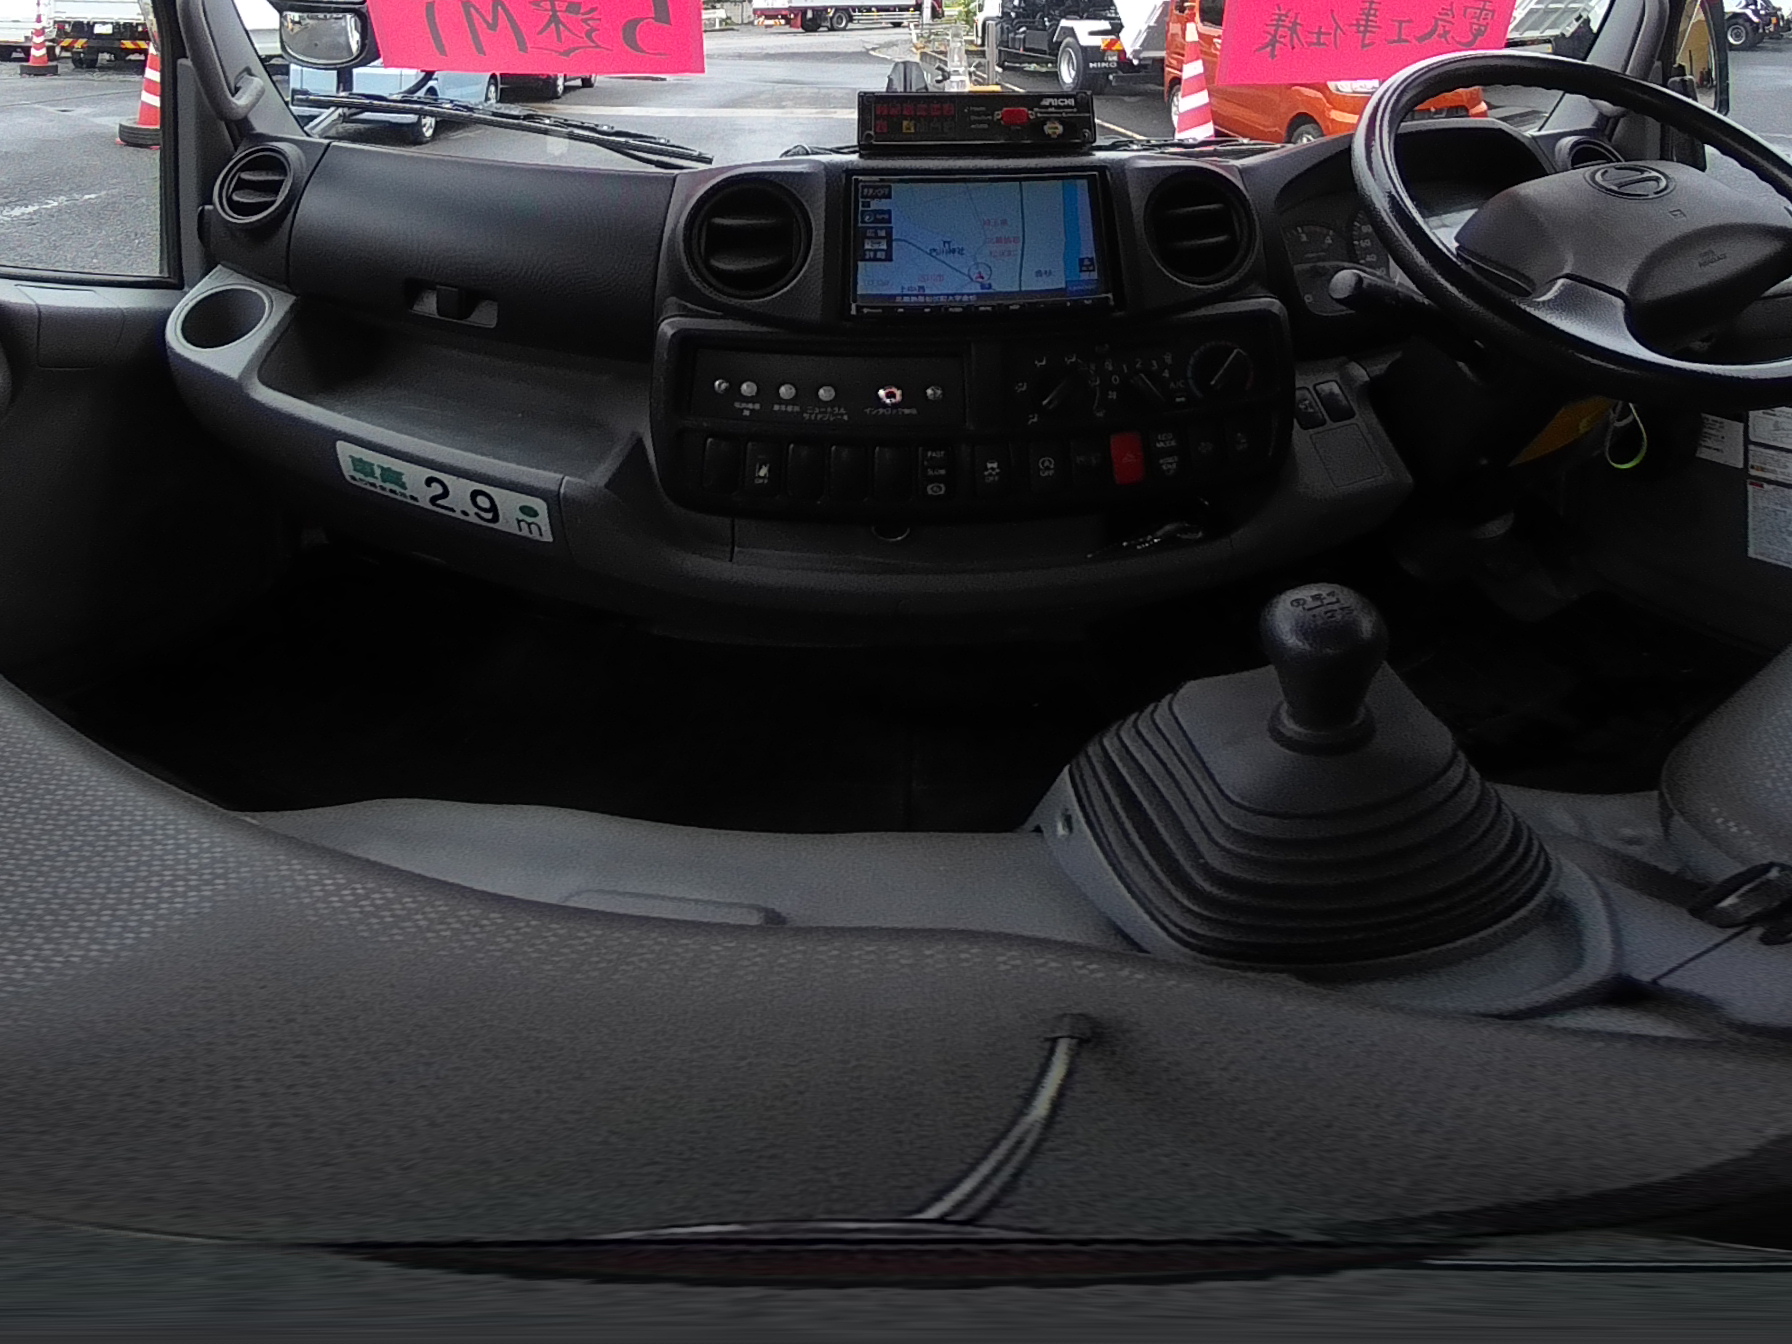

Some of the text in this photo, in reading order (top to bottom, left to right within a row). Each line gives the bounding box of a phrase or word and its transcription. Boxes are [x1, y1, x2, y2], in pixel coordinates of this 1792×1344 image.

[1135, 358, 1143, 368] 2
[1169, 379, 1186, 390] A/C
[424, 475, 500, 524] 2.9
